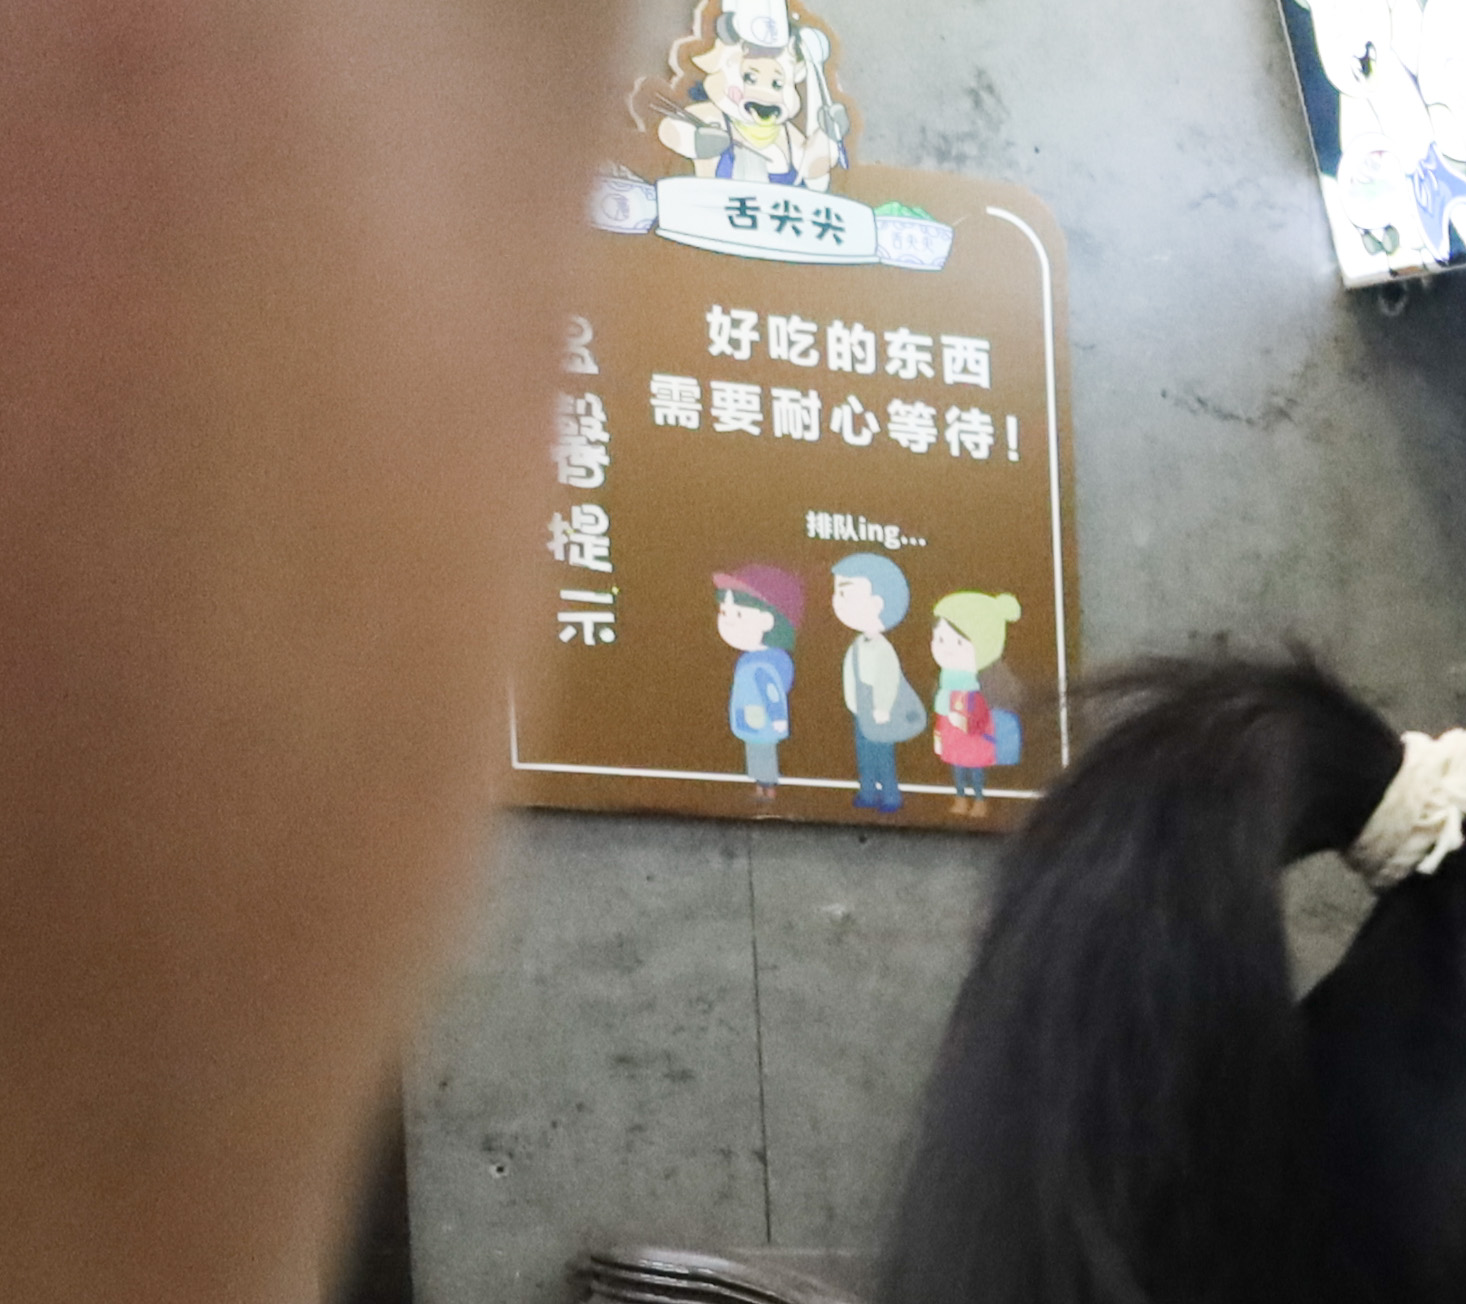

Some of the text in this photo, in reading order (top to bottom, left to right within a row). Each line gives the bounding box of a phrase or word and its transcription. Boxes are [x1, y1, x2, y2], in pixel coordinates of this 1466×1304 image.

[724, 196, 845, 246] 舌尖尖
[705, 304, 992, 390] 好吃的东西
[650, 373, 1020, 462] 需要耐心等待！
